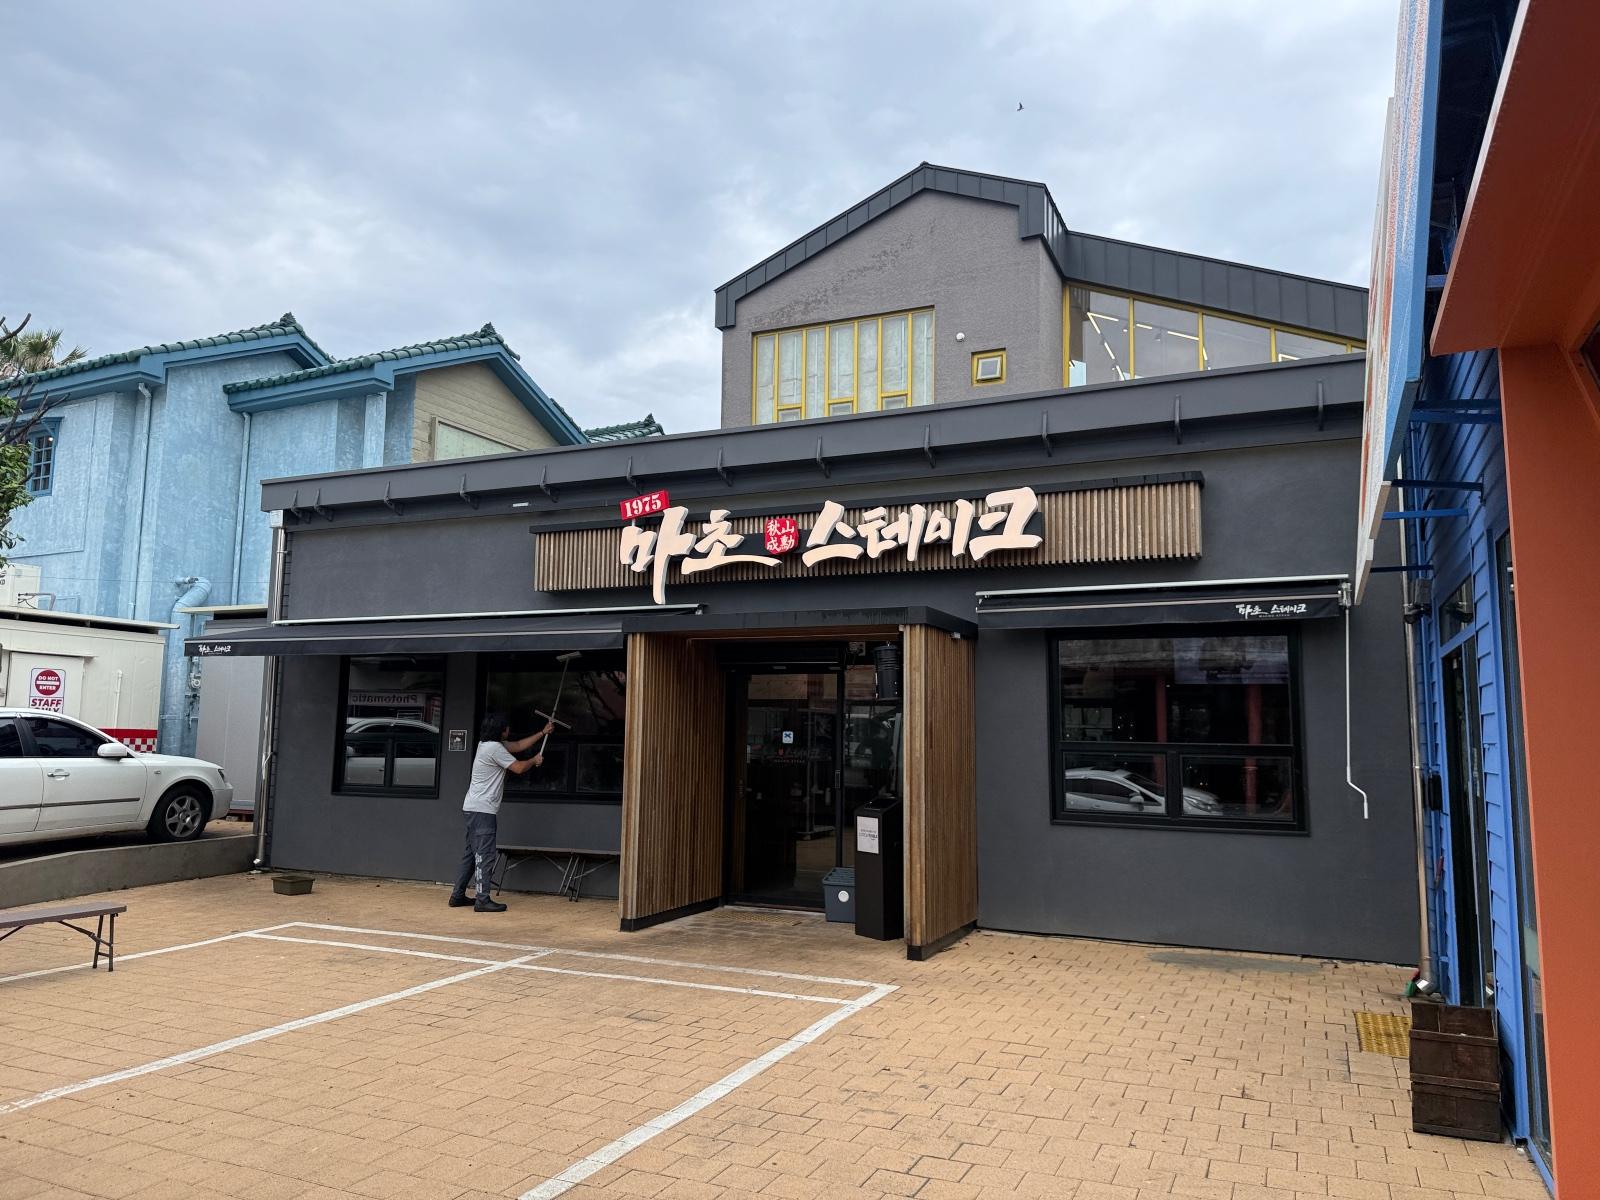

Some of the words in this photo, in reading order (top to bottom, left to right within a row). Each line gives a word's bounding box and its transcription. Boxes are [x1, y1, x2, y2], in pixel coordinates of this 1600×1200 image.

[625, 494, 662, 517] 1975
[766, 519, 795, 537] 秋山
[620, 505, 783, 605] 마초
[802, 486, 1043, 568] 스테이크
[31, 698, 62, 707] STAFF
